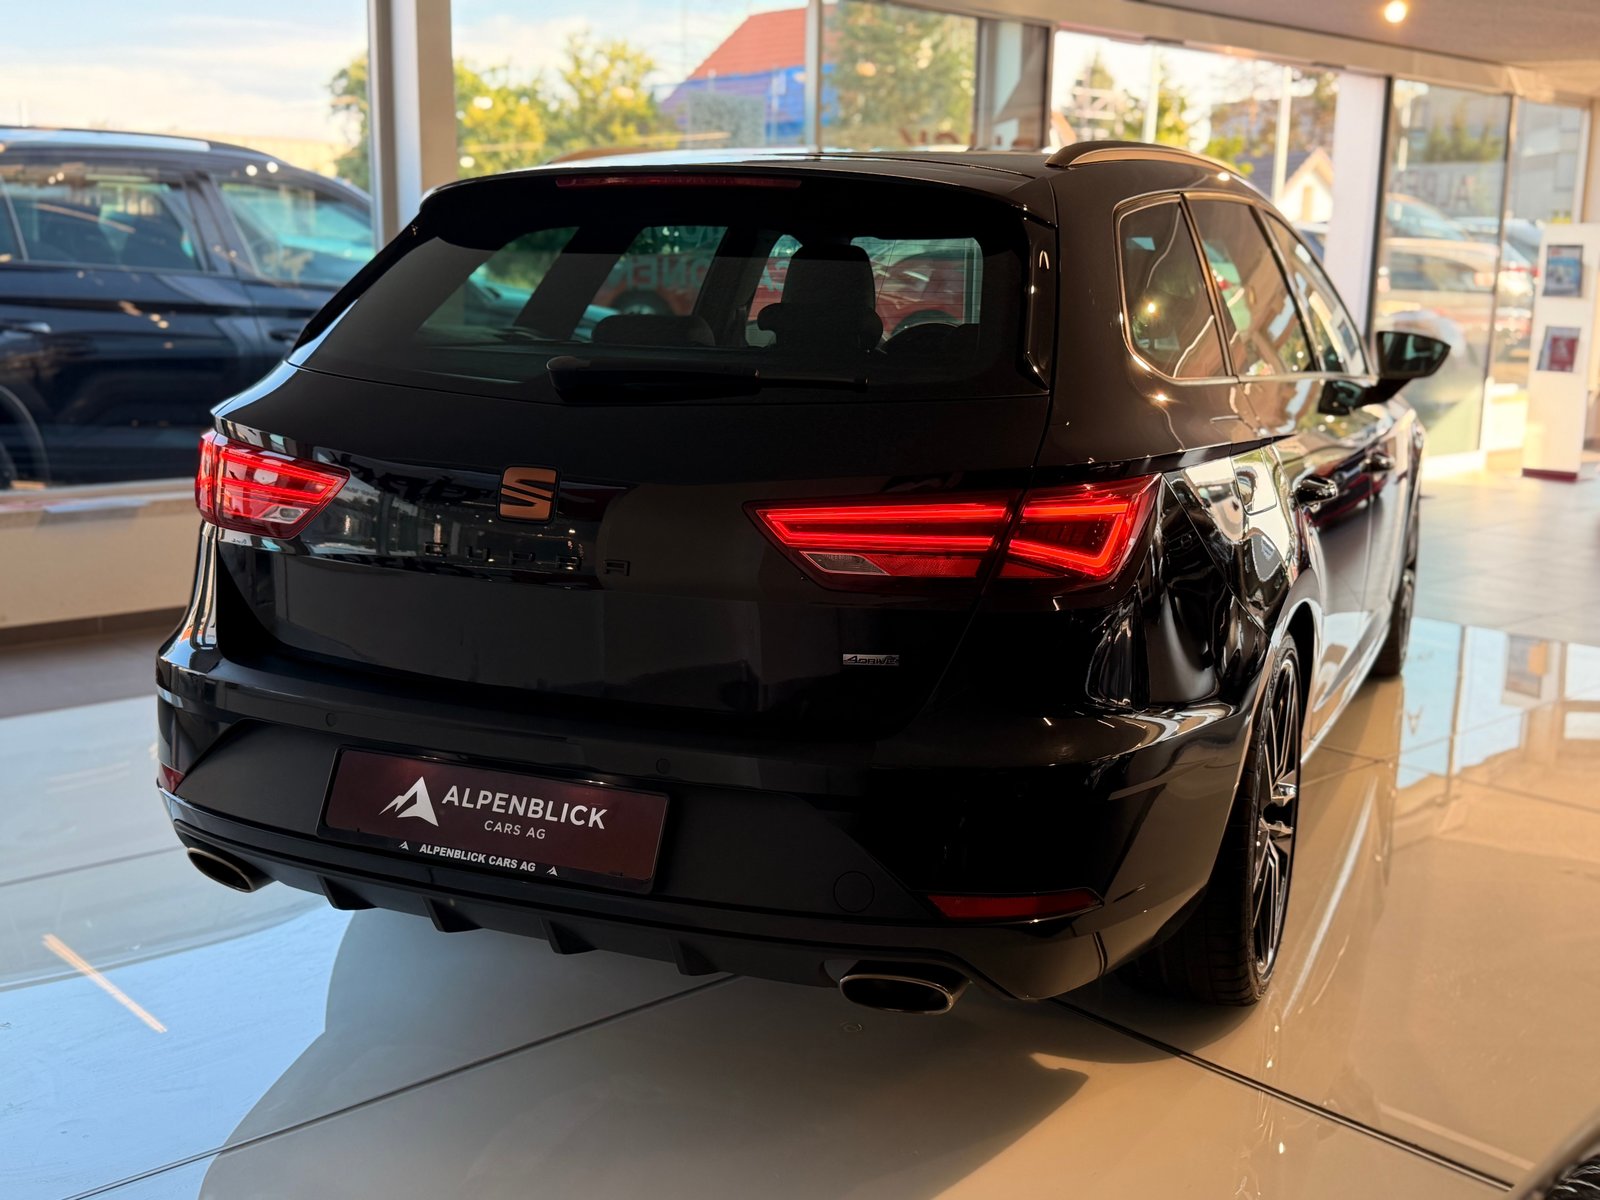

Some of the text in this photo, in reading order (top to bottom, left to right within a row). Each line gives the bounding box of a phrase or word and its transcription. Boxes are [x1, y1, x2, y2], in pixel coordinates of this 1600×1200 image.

[424, 541, 631, 577] CUPRA
[441, 784, 608, 830] ALPENBLICK
[484, 820, 546, 840] CARS AG
[419, 843, 536, 872] ALPENBLICK CARS AG
